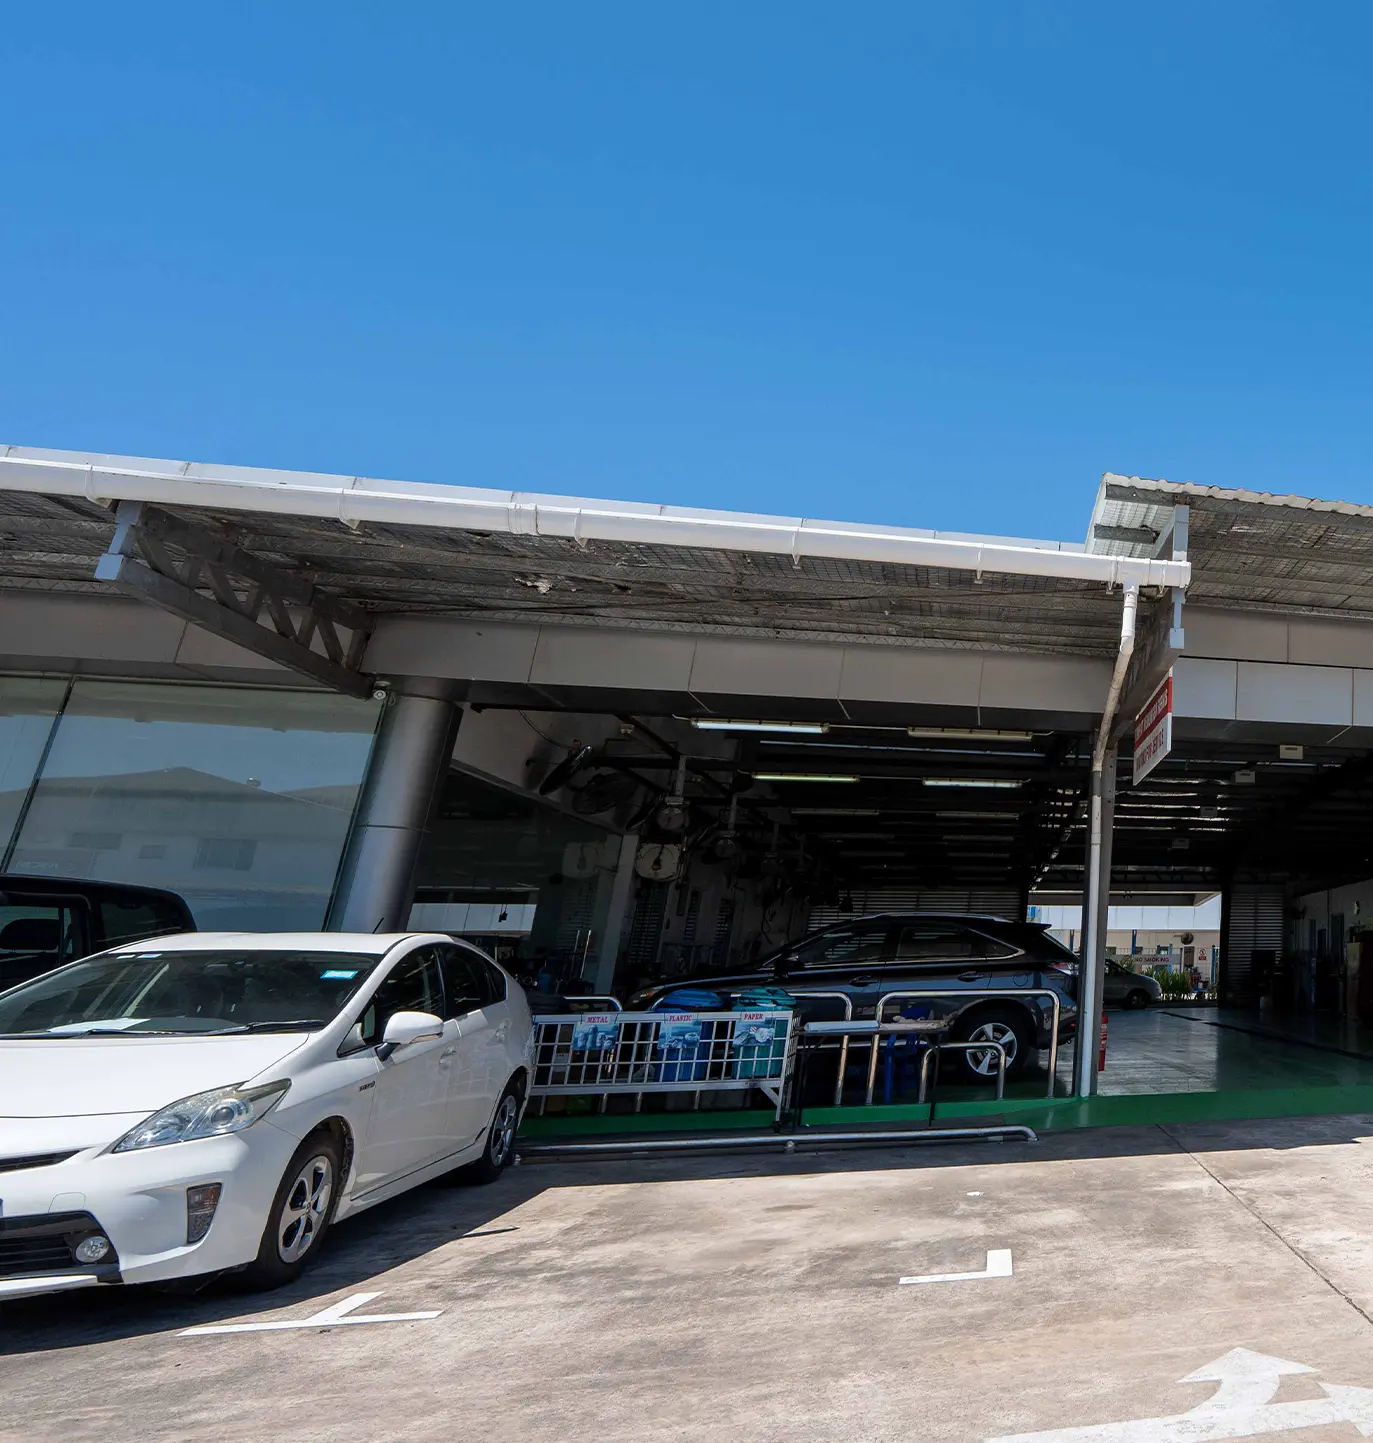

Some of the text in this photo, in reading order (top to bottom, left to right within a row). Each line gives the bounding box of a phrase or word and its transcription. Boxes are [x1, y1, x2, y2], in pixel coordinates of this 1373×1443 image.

[587, 1016, 609, 1024] METAL
[669, 1014, 693, 1022] PLASTIC
[743, 1012, 764, 1020] PAPER
